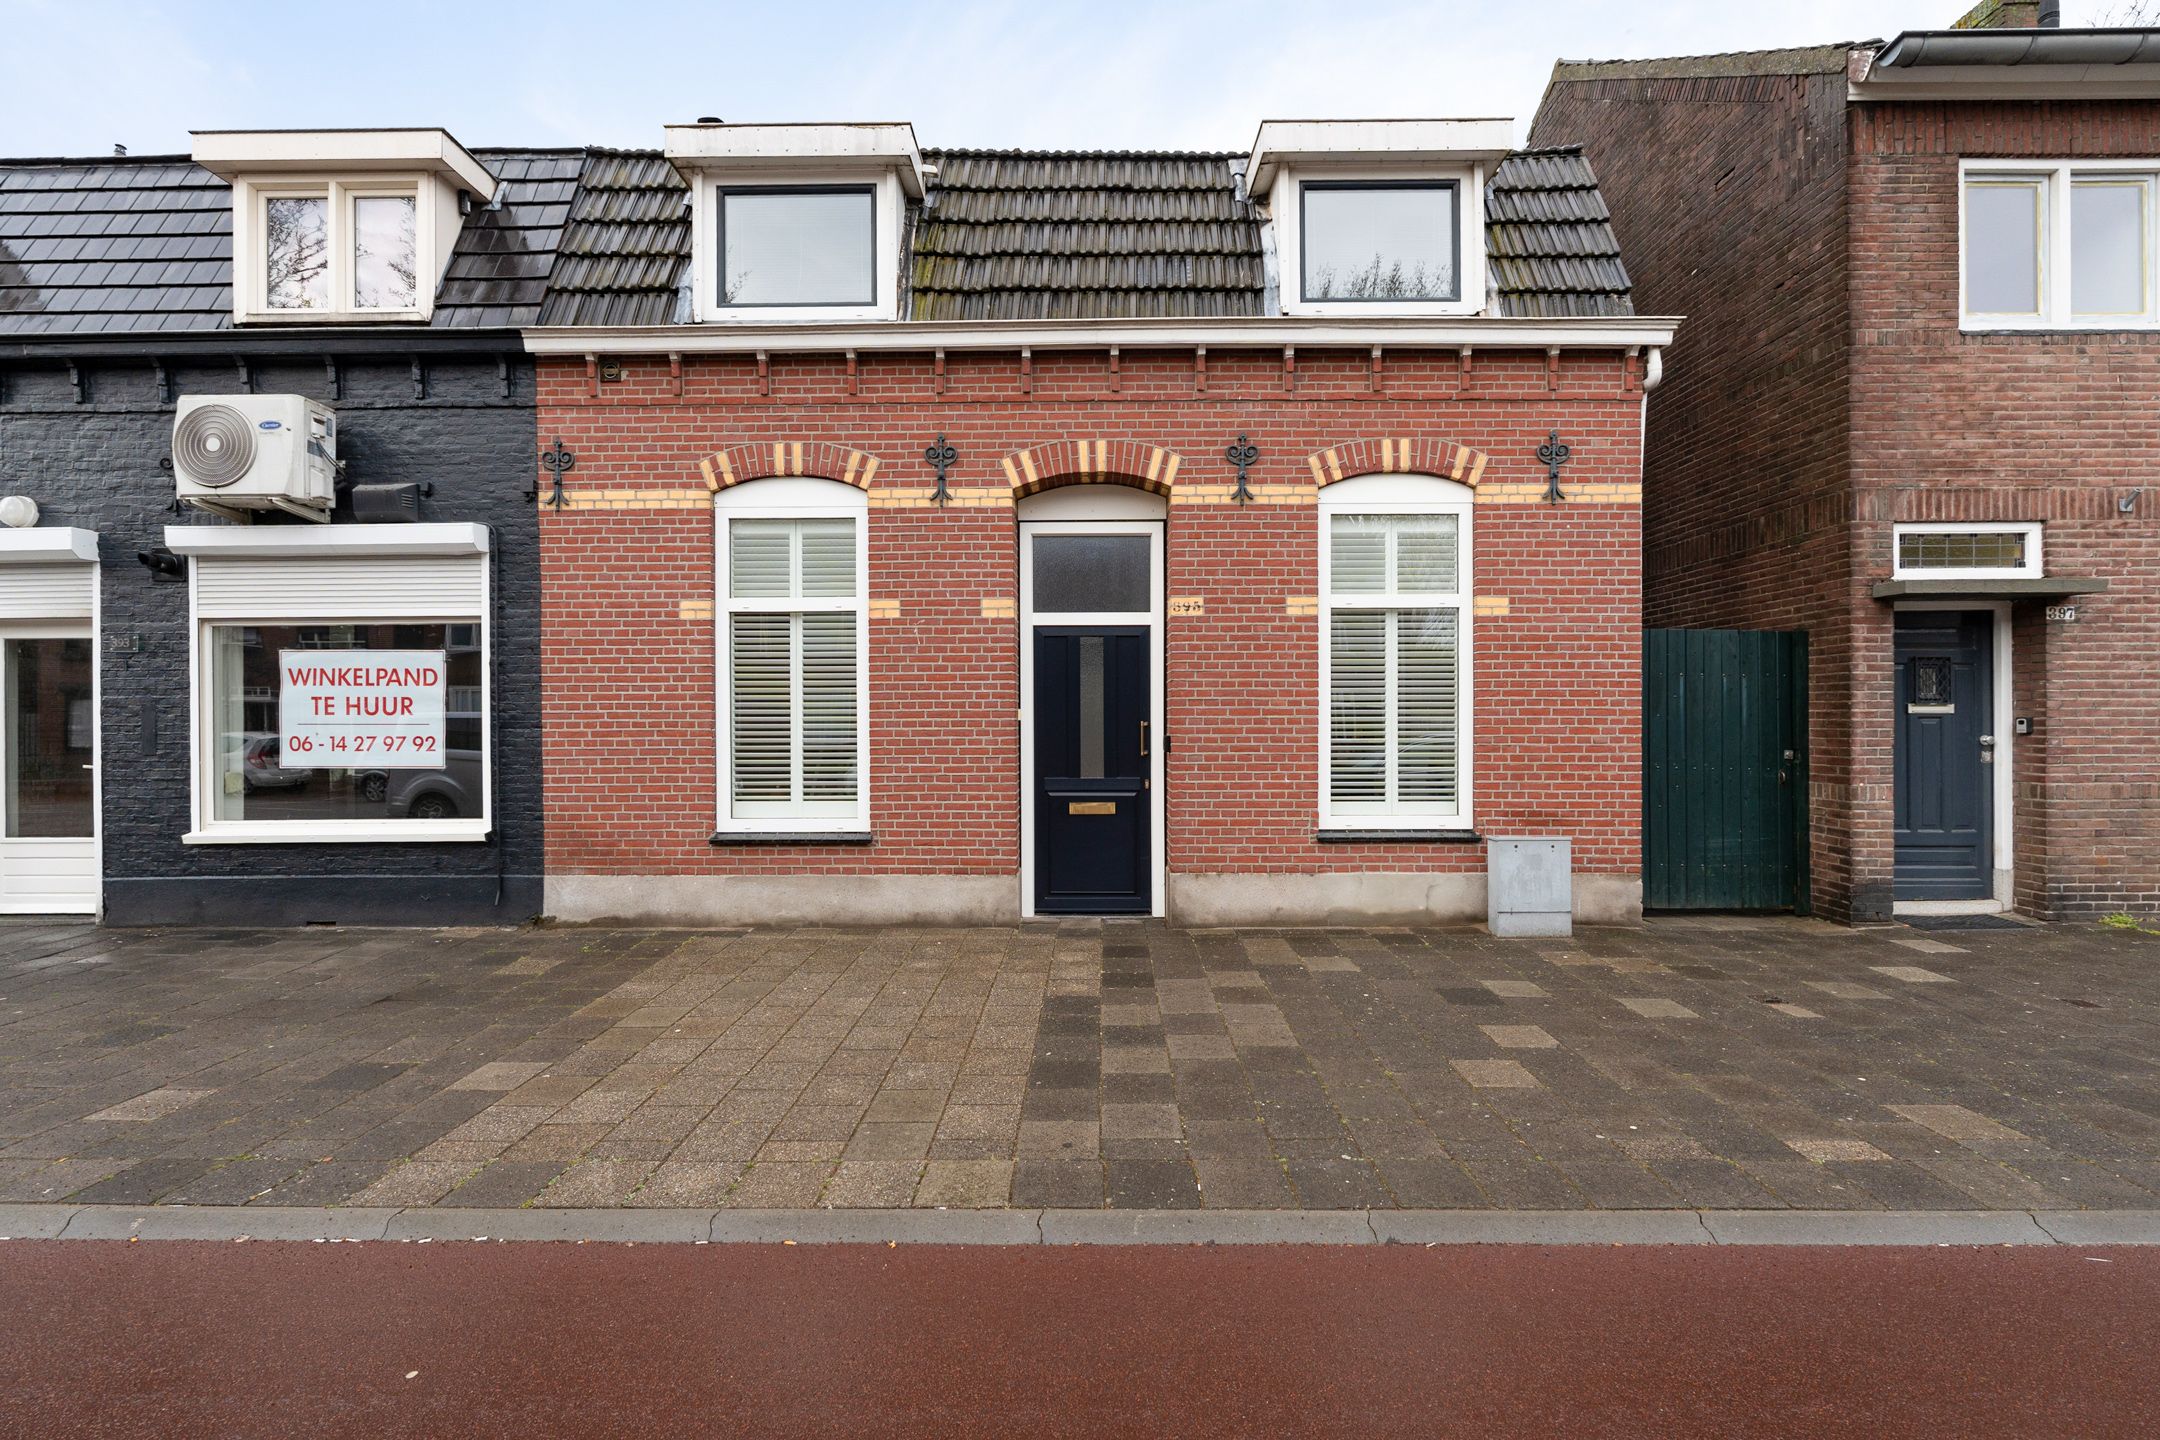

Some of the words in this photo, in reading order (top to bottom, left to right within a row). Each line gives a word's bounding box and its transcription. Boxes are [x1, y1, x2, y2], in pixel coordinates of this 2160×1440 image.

[2048, 607, 2074, 619] 397
[111, 637, 130, 648] 393
[288, 668, 439, 687] WINKELPAND
[311, 696, 335, 716] TE
[346, 696, 414, 716] HUUR
[289, 736, 313, 752] 06
[330, 736, 347, 752] 14
[354, 736, 377, 752] 27
[383, 736, 407, 752] 97
[412, 736, 436, 752] 92
